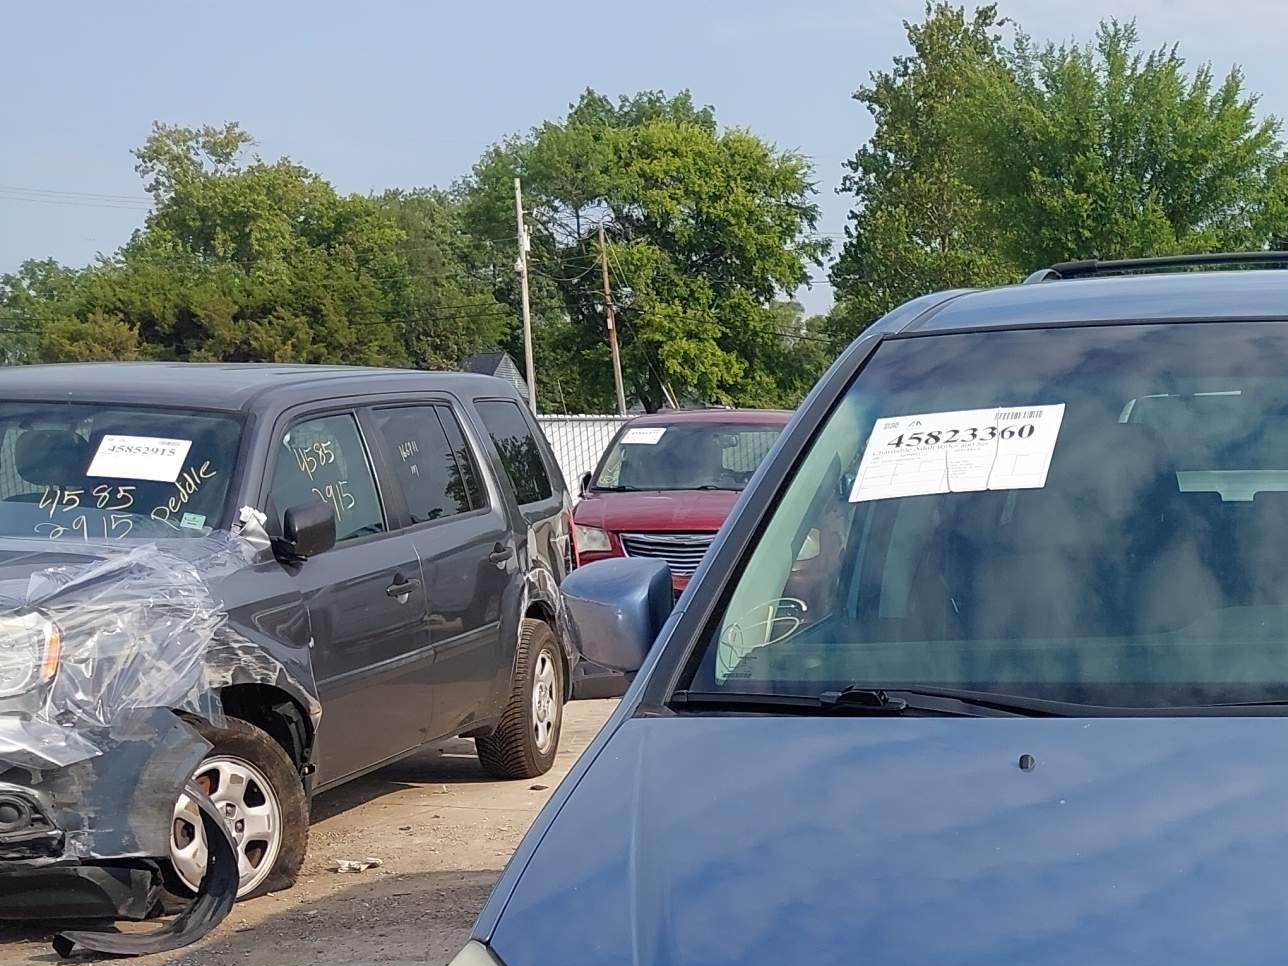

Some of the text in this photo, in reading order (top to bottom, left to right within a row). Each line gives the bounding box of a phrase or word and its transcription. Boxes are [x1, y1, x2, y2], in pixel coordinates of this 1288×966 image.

[107, 445, 176, 457] 45852915
[886, 423, 1035, 448] 45823360
[293, 441, 335, 481] 4585
[312, 480, 355, 522] 2915
